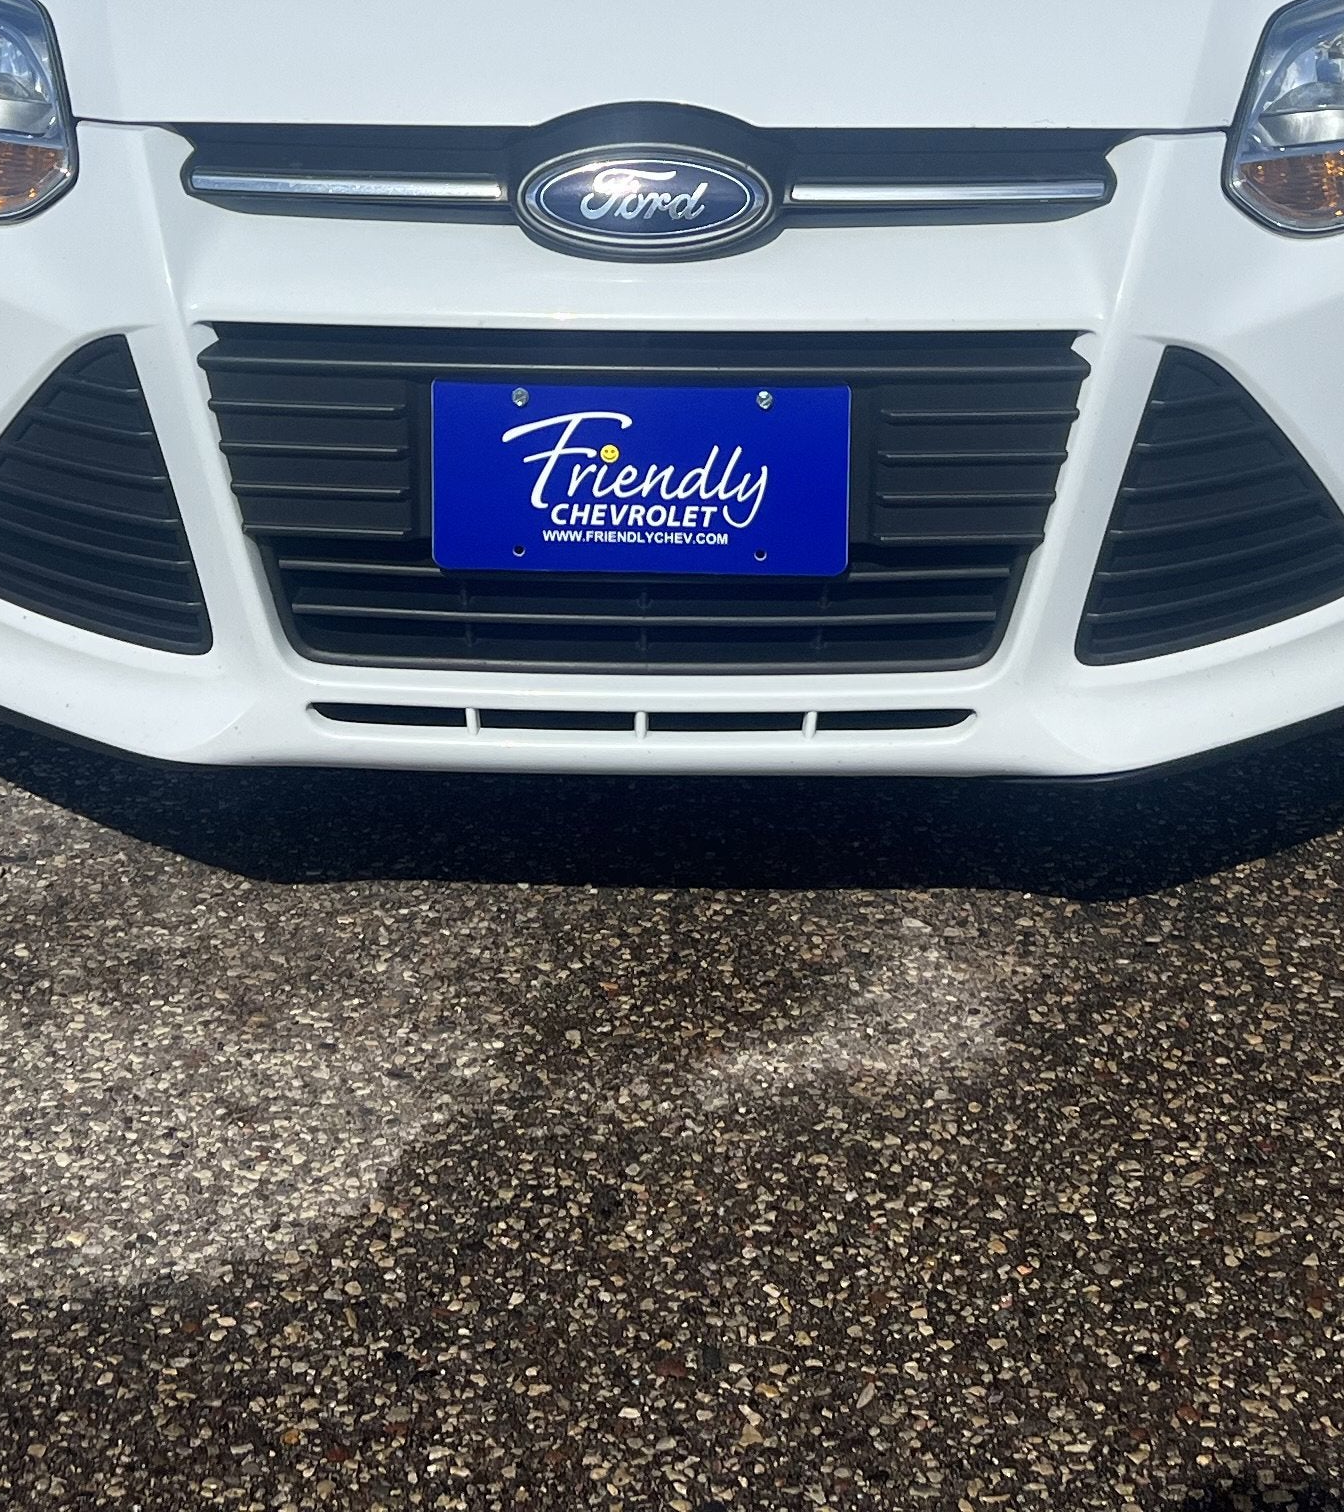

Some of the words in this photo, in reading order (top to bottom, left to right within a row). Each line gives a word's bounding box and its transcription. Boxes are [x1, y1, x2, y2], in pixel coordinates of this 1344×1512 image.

[580, 168, 709, 221] Ford
[502, 410, 769, 529] Friendly
[550, 502, 718, 529] CHEVROLET
[542, 529, 729, 546] WWW.FRIENDLYCHEV.COM
